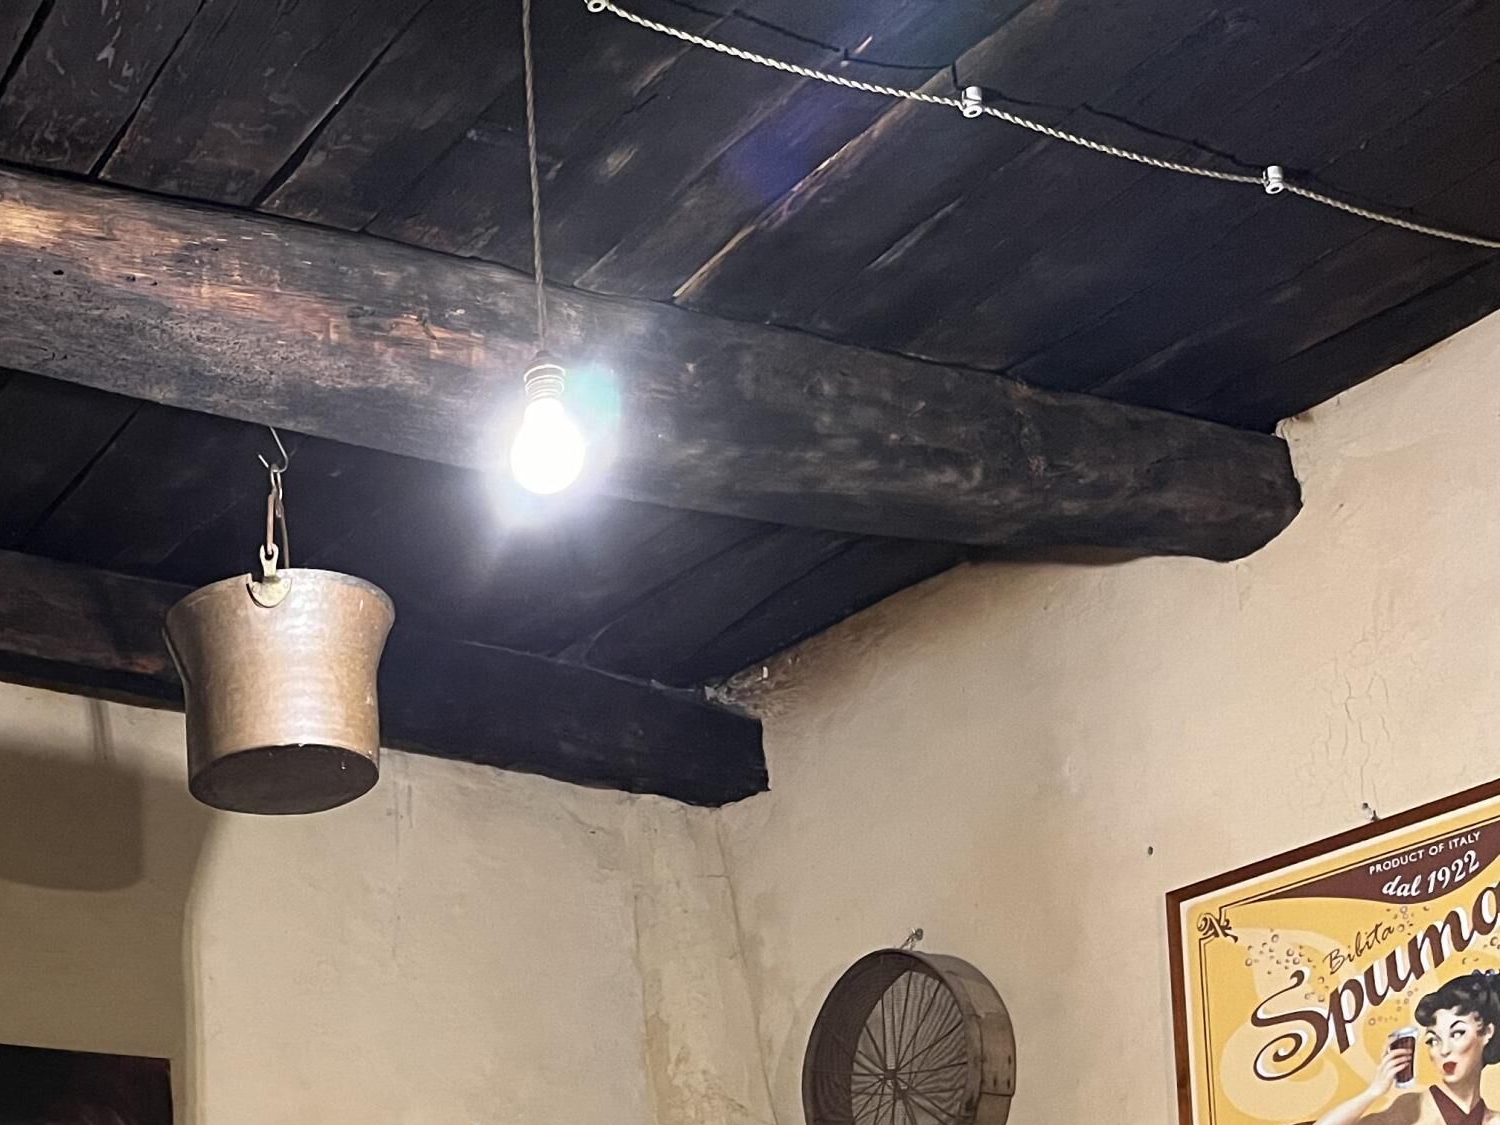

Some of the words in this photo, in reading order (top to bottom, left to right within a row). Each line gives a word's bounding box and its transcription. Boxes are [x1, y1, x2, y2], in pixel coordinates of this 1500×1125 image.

[1369, 849, 1425, 875] PRODUCT
[1428, 843, 1445, 857] OF
[1449, 831, 1481, 850] ITALY
[1381, 875, 1421, 897] dal
[1427, 849, 1480, 894] 1922
[1323, 921, 1395, 976] Bibita
